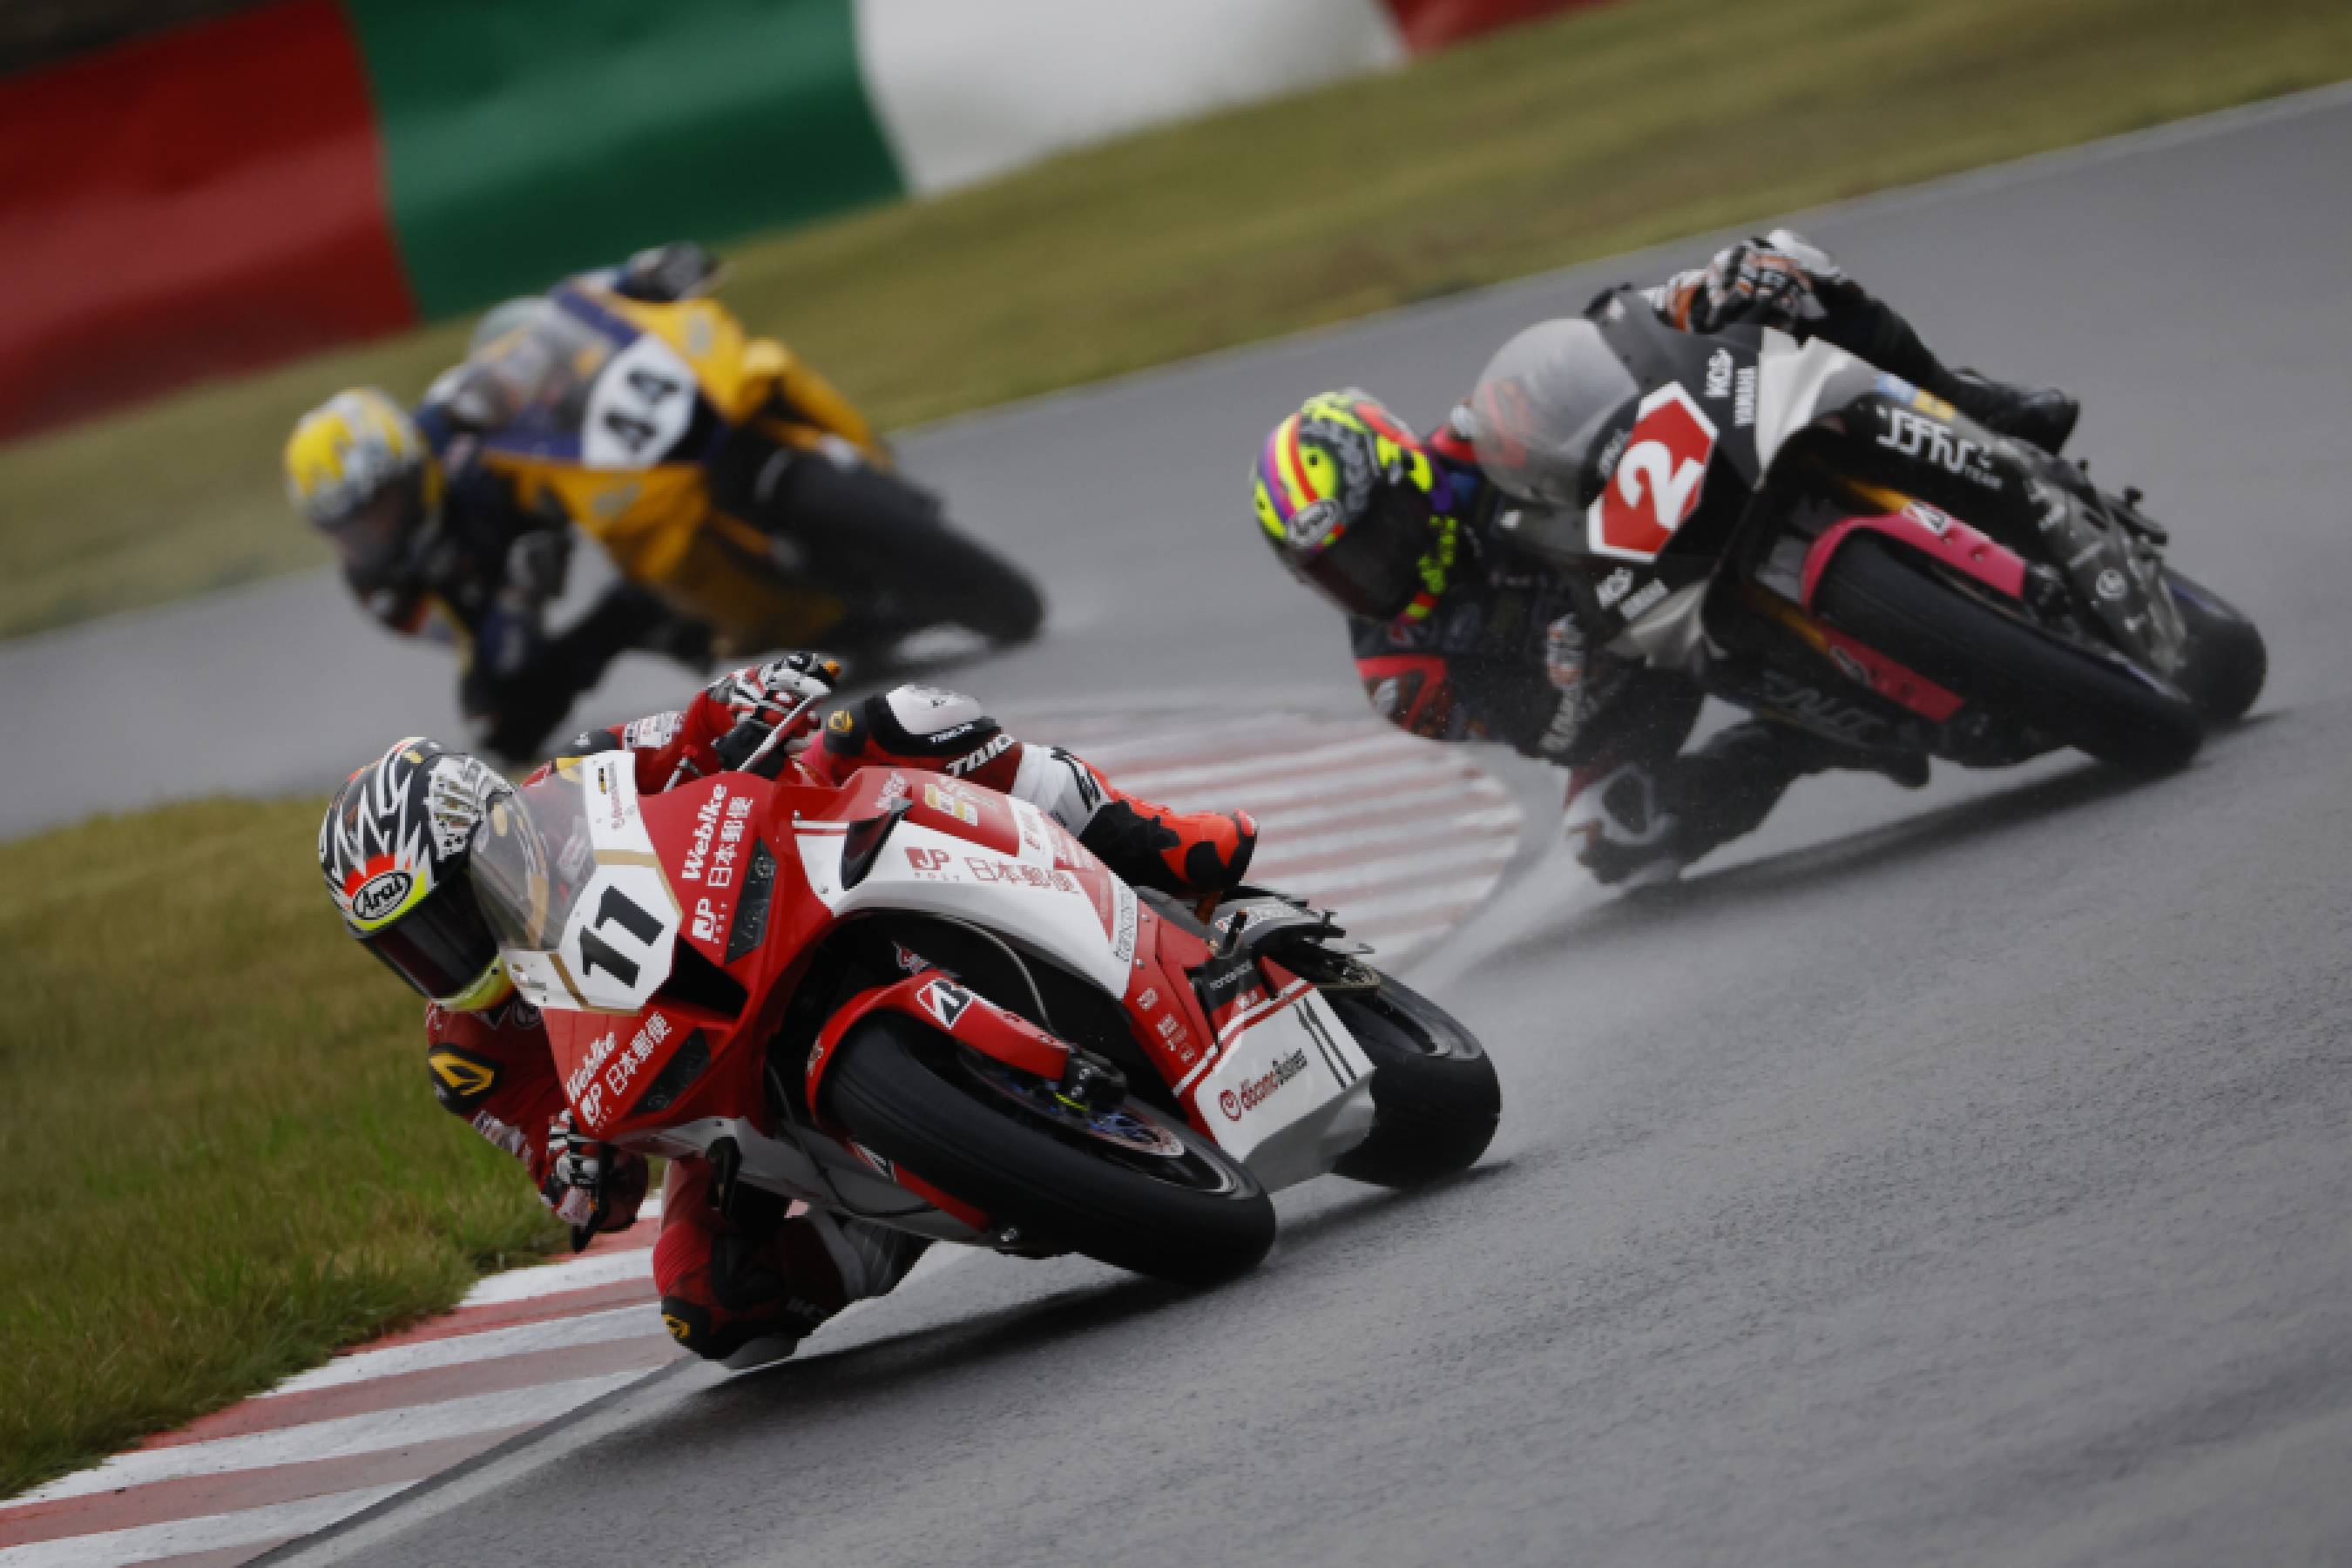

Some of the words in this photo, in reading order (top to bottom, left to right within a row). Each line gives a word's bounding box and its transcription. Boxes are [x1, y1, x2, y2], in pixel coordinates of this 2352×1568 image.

[602, 367, 679, 453] 44
[1618, 442, 1705, 530] 2
[707, 796, 754, 888] 日本郵便
[964, 856, 1080, 894] 日本郵便
[362, 876, 403, 912] Arai
[578, 884, 665, 990] 11
[606, 1011, 672, 1096] 日本郵便
